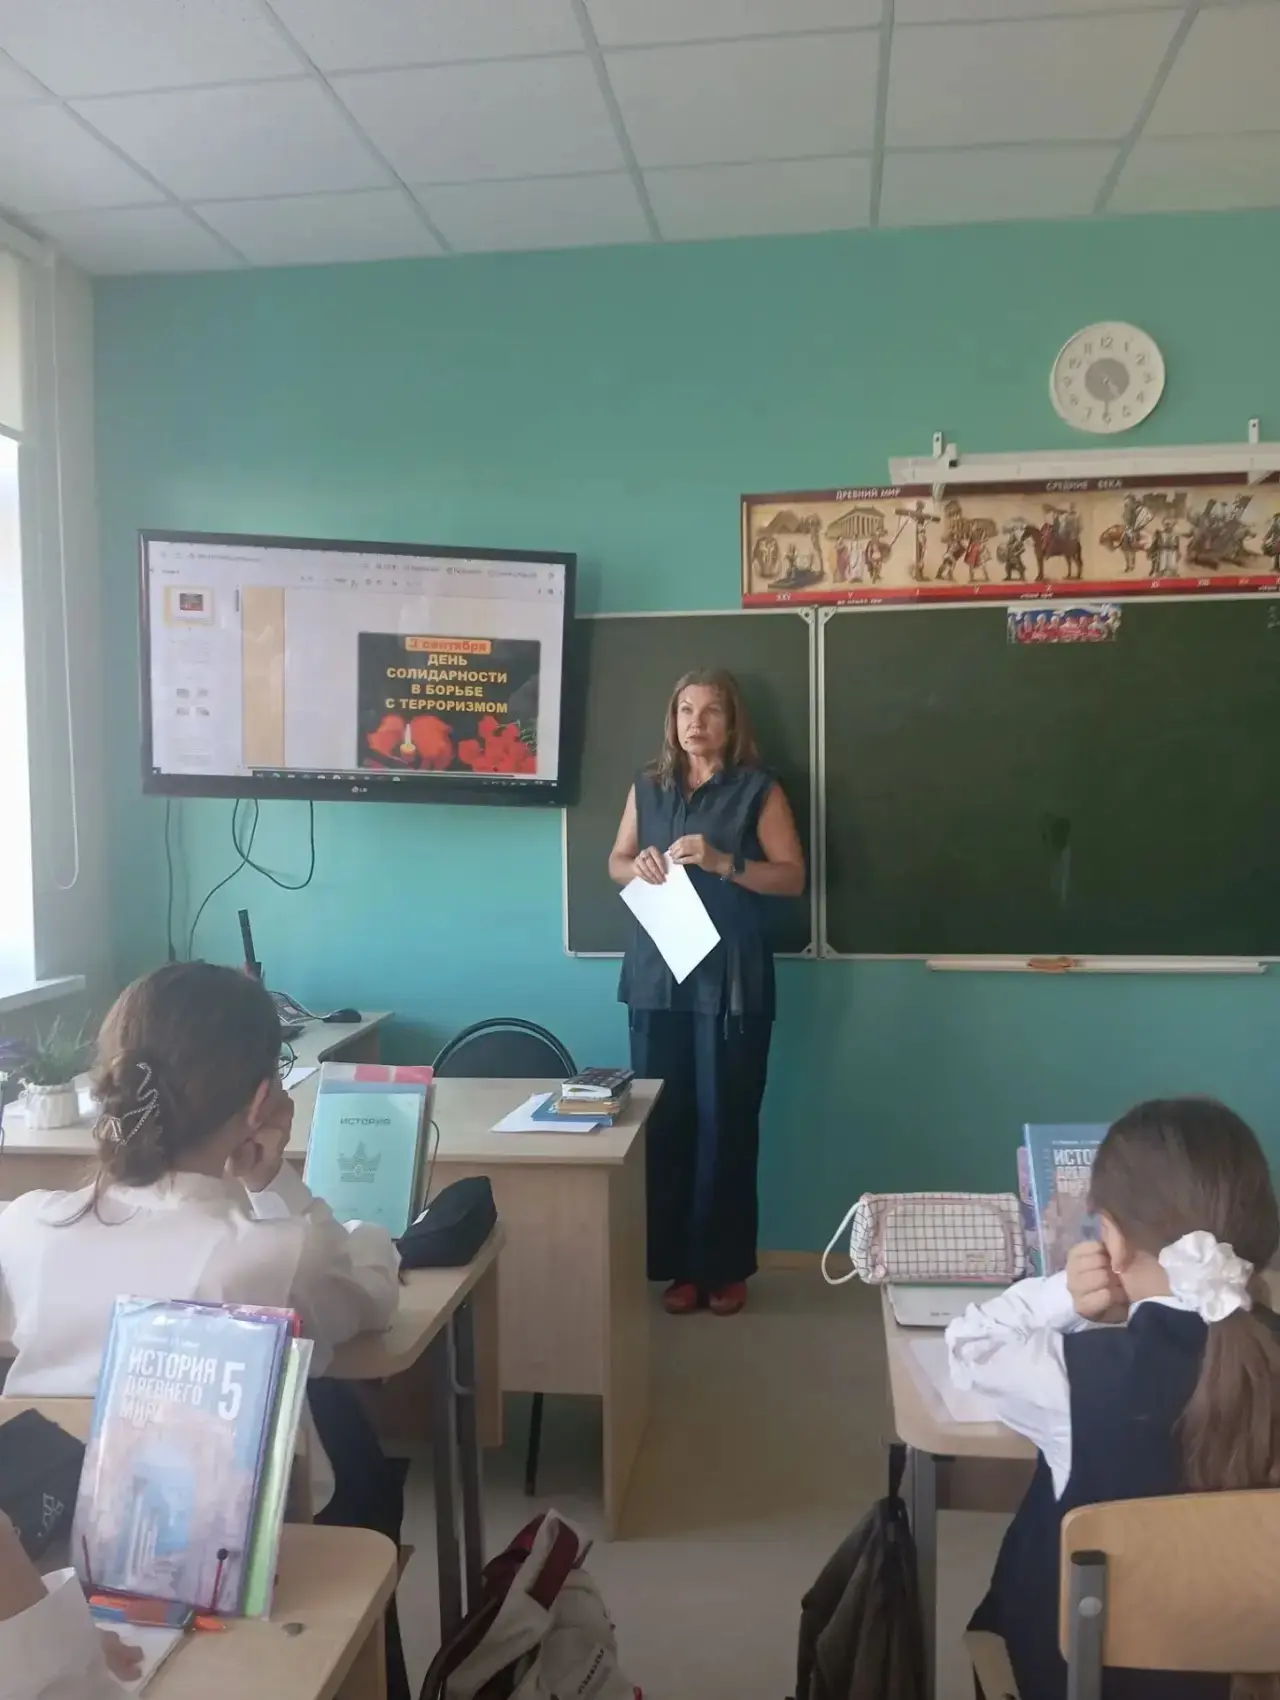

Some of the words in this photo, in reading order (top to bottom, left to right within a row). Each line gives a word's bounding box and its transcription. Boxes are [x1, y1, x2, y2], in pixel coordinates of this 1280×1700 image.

[1100, 335, 1113, 349] 12
[1124, 340, 1130, 353] 1
[1135, 353, 1146, 367] 2
[1136, 391, 1144, 405] 4
[1084, 406, 1092, 420] 7
[836, 488, 878, 501] ДРЕВНИЙ
[880, 487, 900, 498] МИР
[427, 654, 468, 666] ДЕНЬ
[386, 667, 507, 683] СОЛИДАРНОСТИ
[411, 684, 420, 695] В
[426, 685, 483, 697] БОРЬБЕ
[385, 699, 395, 708] С
[400, 699, 507, 713] ТЕРРОРИЗМОМ
[128, 1347, 217, 1385] ИСТОРИЯ
[124, 1375, 203, 1405] ДРЕВНЕГО
[218, 1361, 245, 1421] 5
